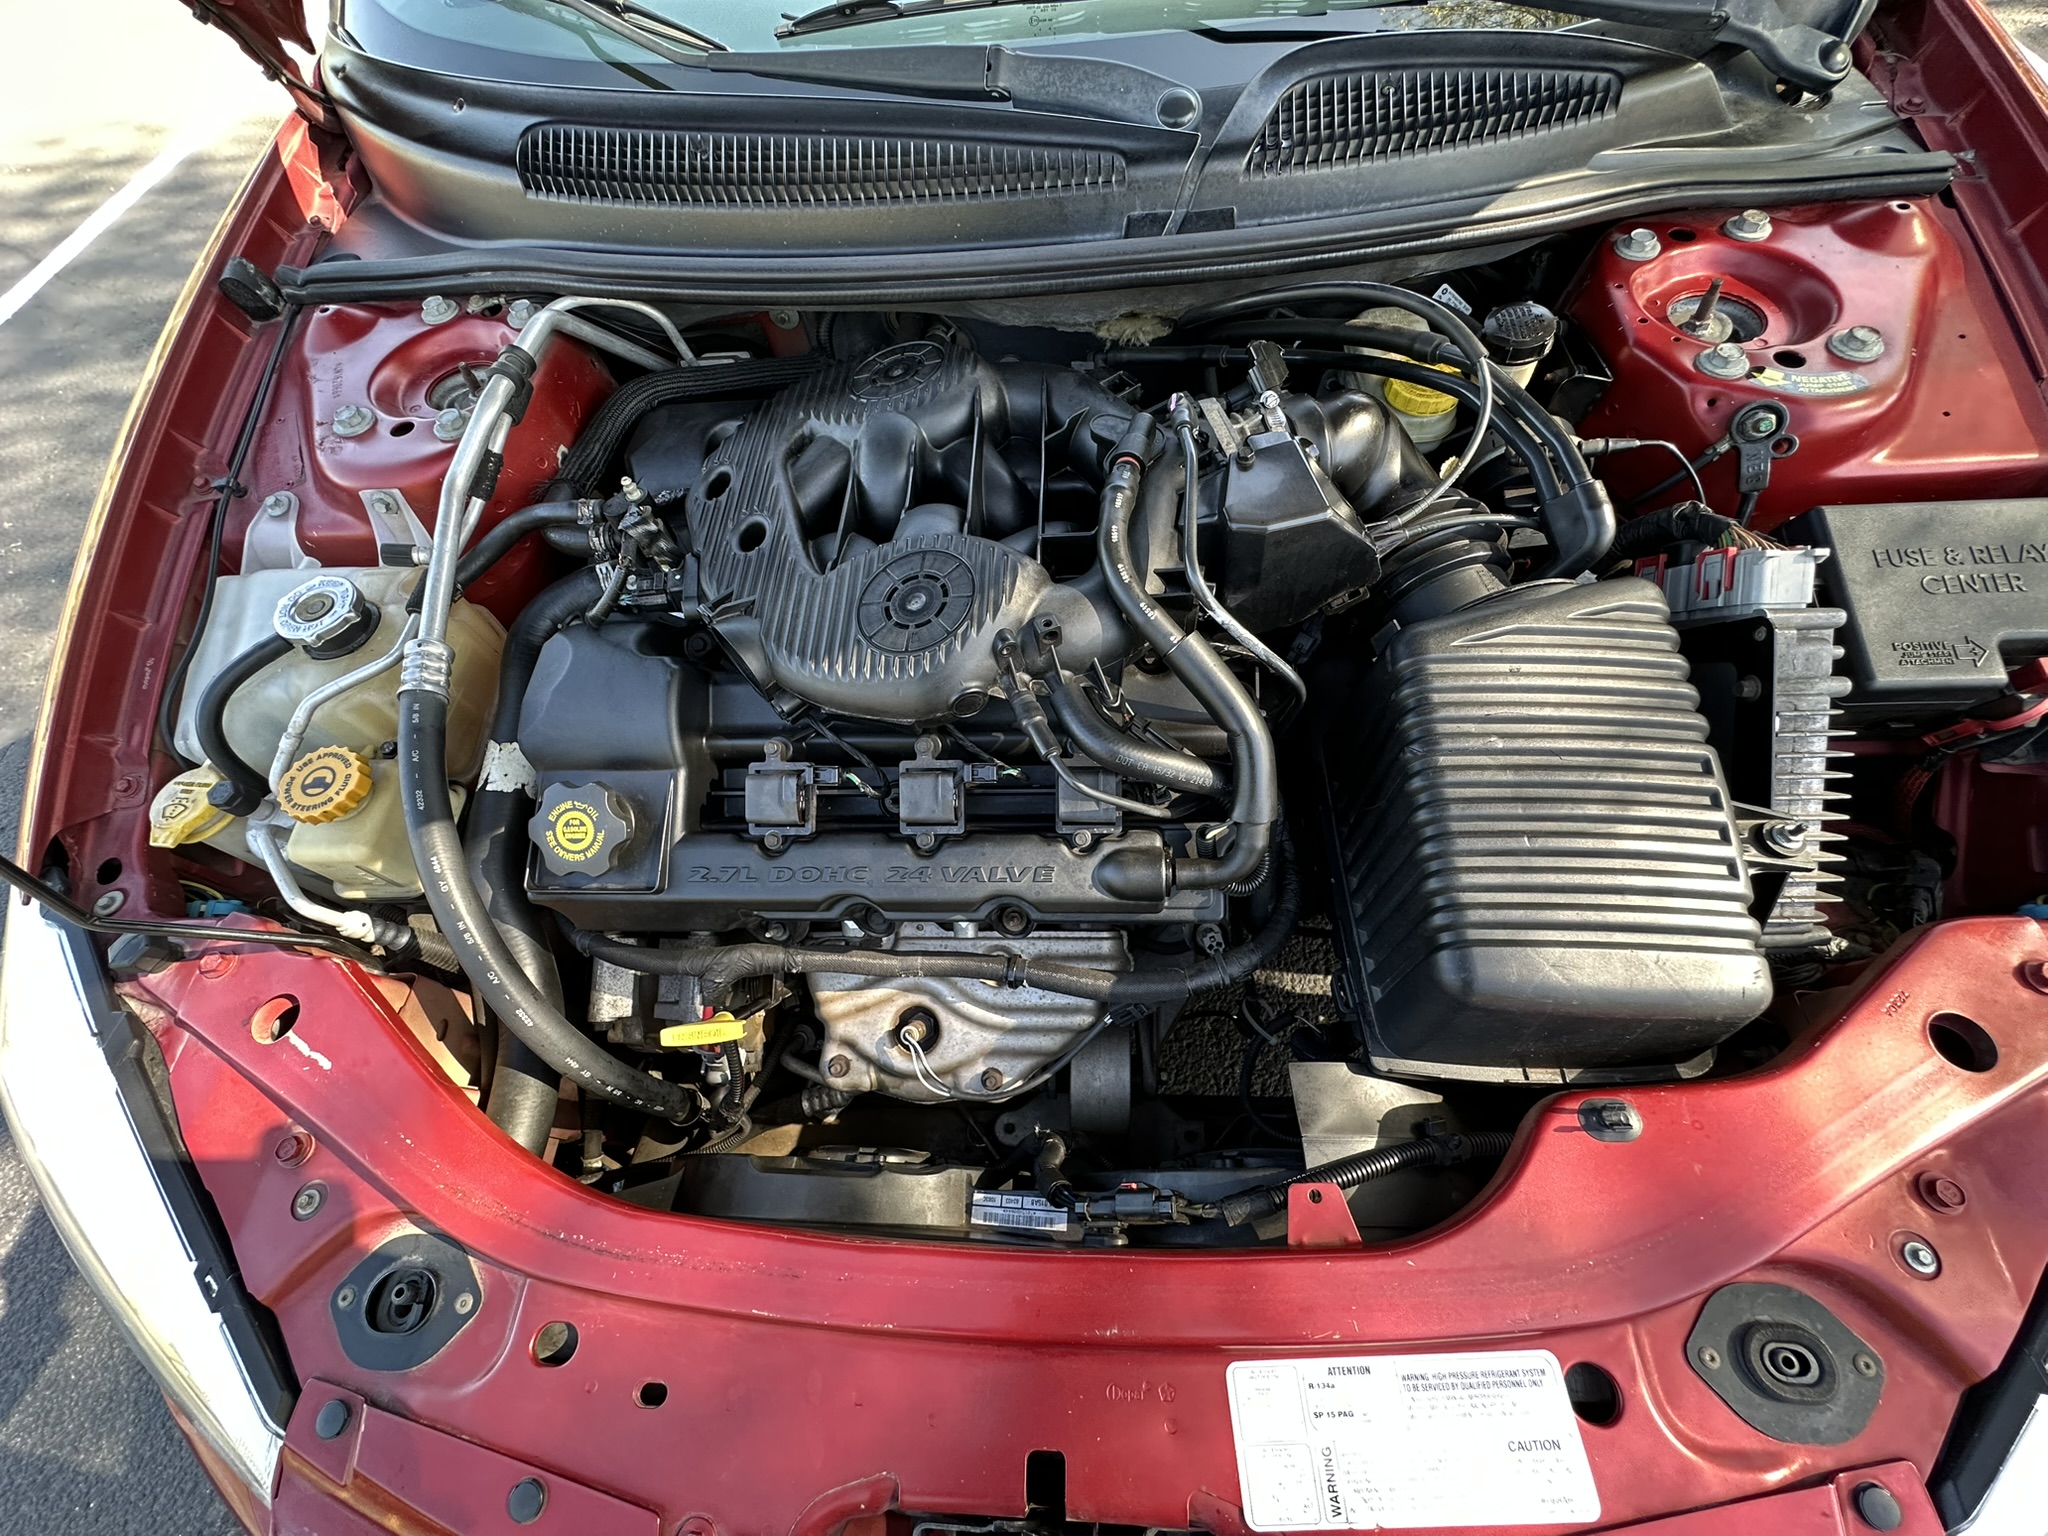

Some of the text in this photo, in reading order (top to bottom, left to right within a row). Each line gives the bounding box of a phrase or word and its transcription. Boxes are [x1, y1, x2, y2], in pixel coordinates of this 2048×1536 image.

[1791, 373, 1851, 384] NEGATIVE
[1872, 543, 2048, 568] FUSE & RELAY
[1117, 563, 1130, 584] 18519
[1920, 573, 2029, 595] CENTER
[1139, 602, 1157, 620] 18519
[1891, 641, 1951, 652] POSITIVE
[296, 752, 352, 772] USE APPROVED
[412, 750, 420, 762] A/C
[1115, 754, 1135, 767] DOT
[1153, 766, 1176, 779] 15/32
[284, 773, 352, 812] POWER STEERING FLUID
[548, 800, 600, 822] ENGINE OIL
[545, 829, 605, 862] SEE OWNERS MANUAL
[687, 865, 1056, 883] 2.7L DOHC 24 VALVE
[1327, 1365, 1371, 1376] ATTENTION
[1432, 1372, 1447, 1381] HIGH
[1448, 1370, 1479, 1380] PRESSURE
[1480, 1369, 1521, 1379] REFRIGERANT
[1521, 1368, 1546, 1378] SYSTEM
[1402, 1378, 1544, 1392] TO BE SERVICED BY QUALIFIED PERSONNEL ONLY
[1313, 1411, 1324, 1419] SP
[1326, 1410, 1336, 1418] 15
[1337, 1410, 1355, 1418] PAG
[1507, 1439, 1562, 1452] CAUTION
[1321, 1446, 1343, 1518] WARNING
